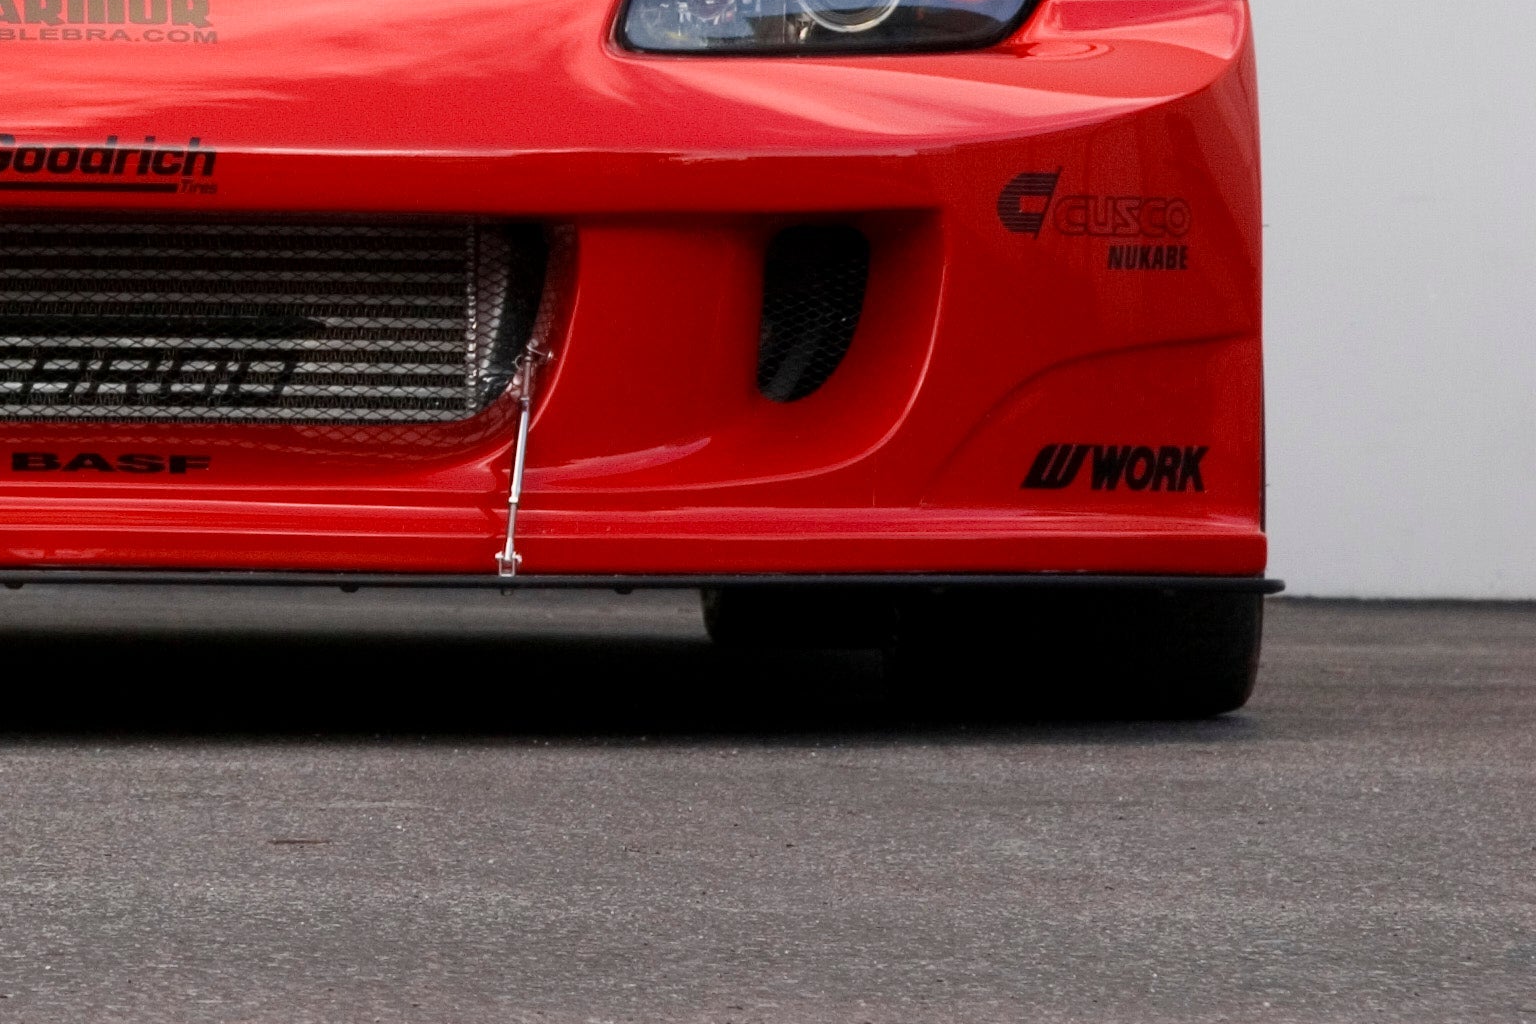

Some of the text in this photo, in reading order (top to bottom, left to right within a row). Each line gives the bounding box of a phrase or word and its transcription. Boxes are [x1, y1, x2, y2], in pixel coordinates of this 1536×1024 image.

[1053, 194, 1192, 239] CUSCO
[1107, 244, 1189, 271] NUKABE
[11, 451, 212, 474] BASF
[1089, 445, 1209, 493] WORK
